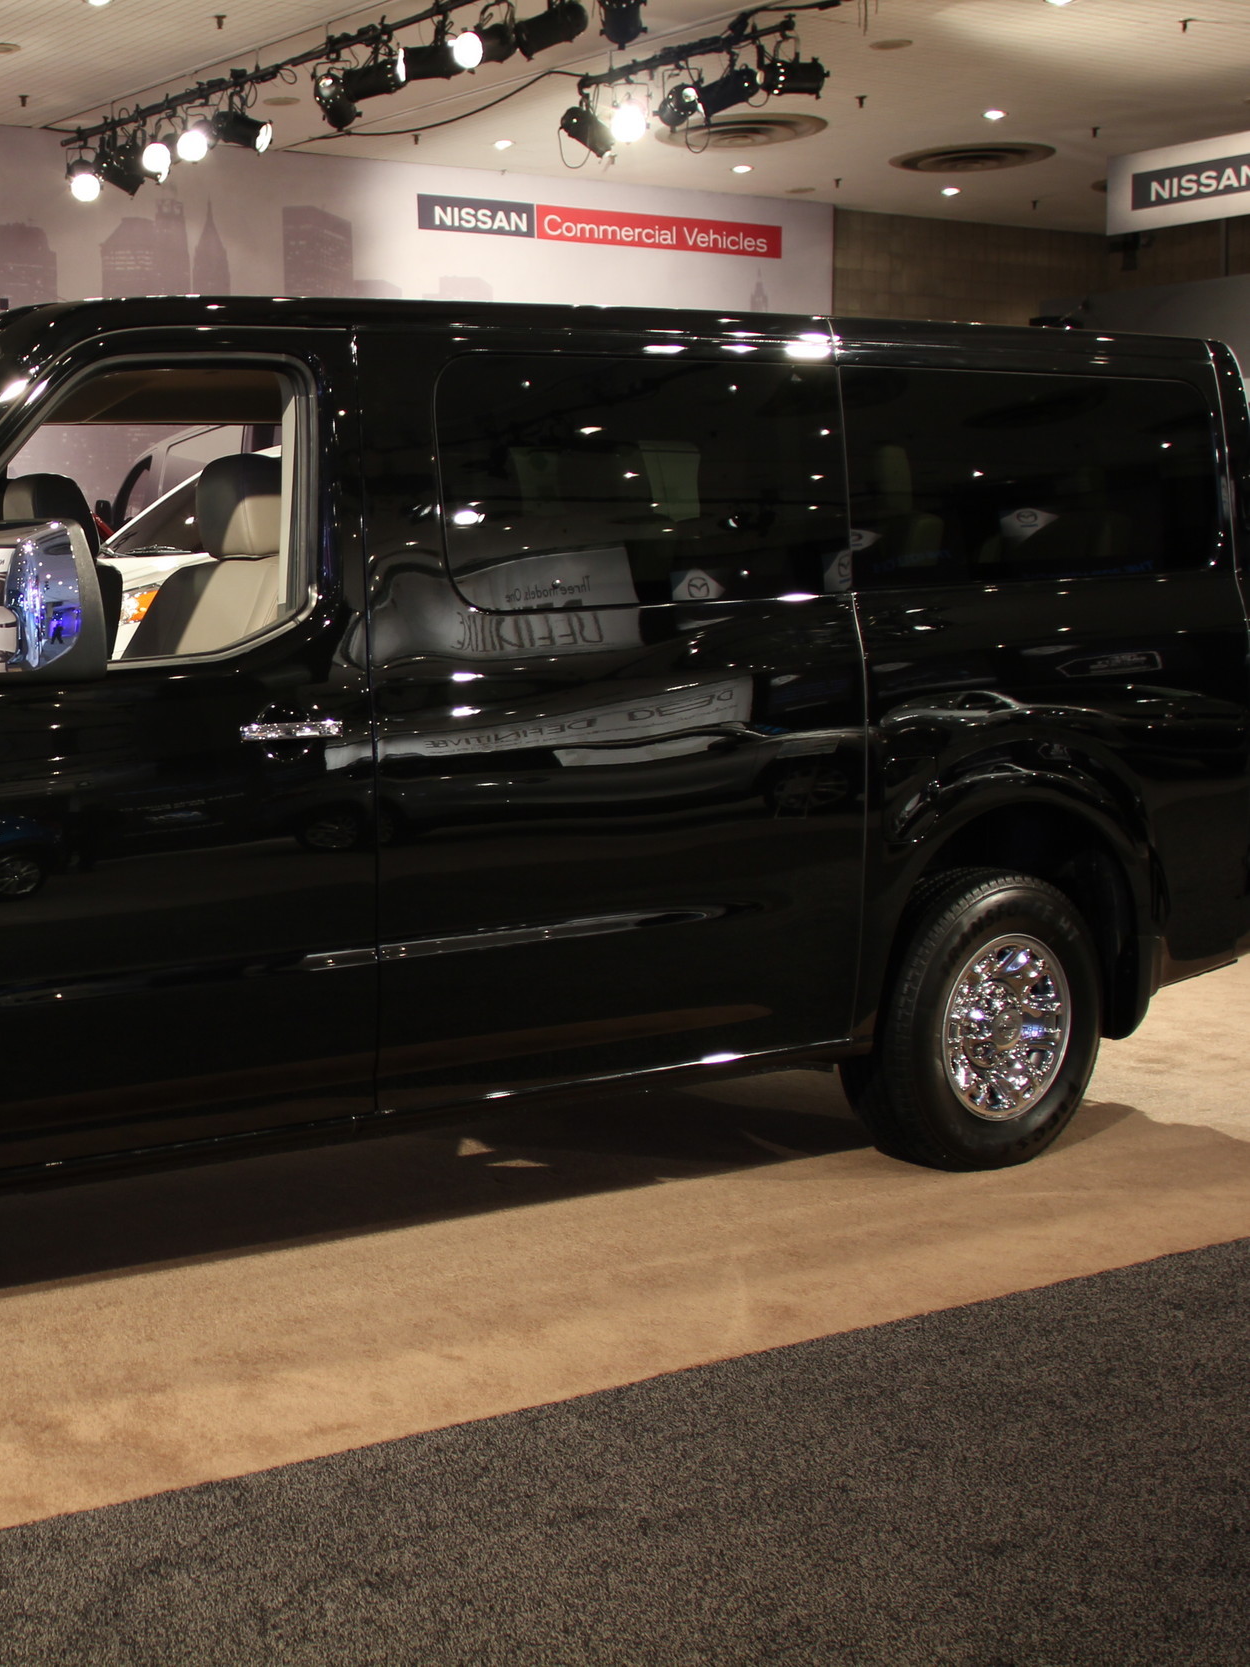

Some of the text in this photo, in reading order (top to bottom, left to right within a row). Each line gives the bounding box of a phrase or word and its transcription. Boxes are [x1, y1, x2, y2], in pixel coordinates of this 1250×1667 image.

[433, 205, 768, 253] NISSAN Commercial Vehicles
